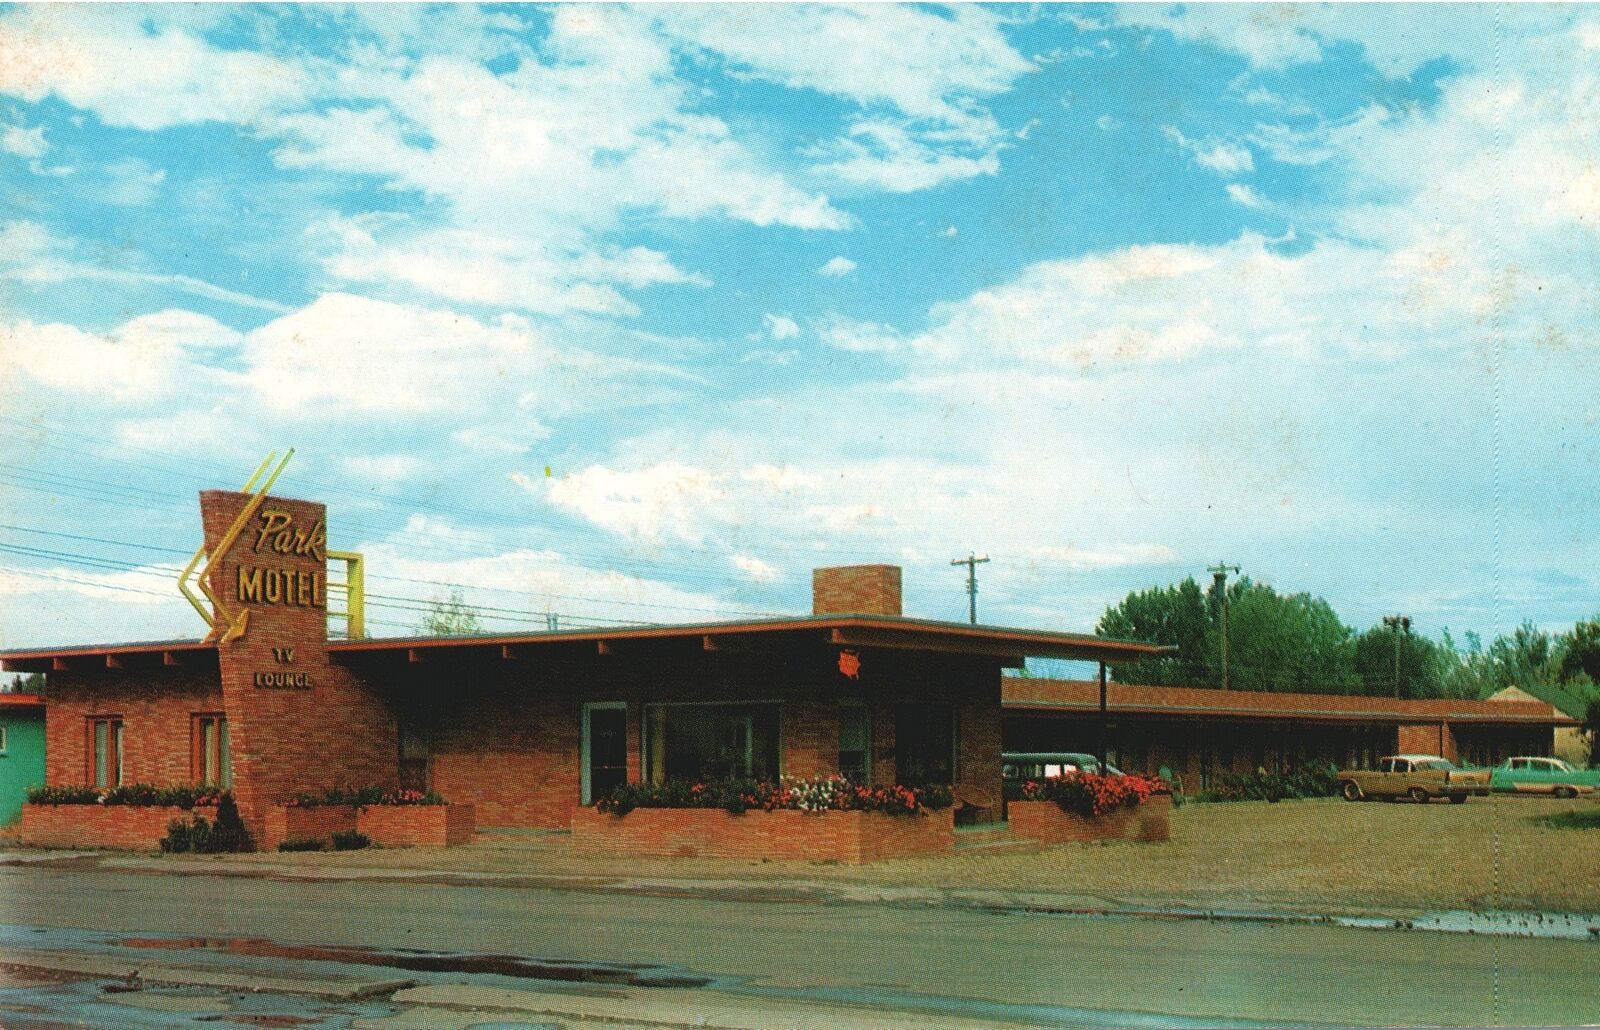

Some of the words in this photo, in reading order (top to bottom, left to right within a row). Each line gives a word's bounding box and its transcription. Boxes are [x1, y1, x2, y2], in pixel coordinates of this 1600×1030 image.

[256, 510, 326, 561] Park
[237, 564, 326, 607] MOTEL
[273, 647, 294, 663] TV
[254, 671, 314, 689] LOUNGE
